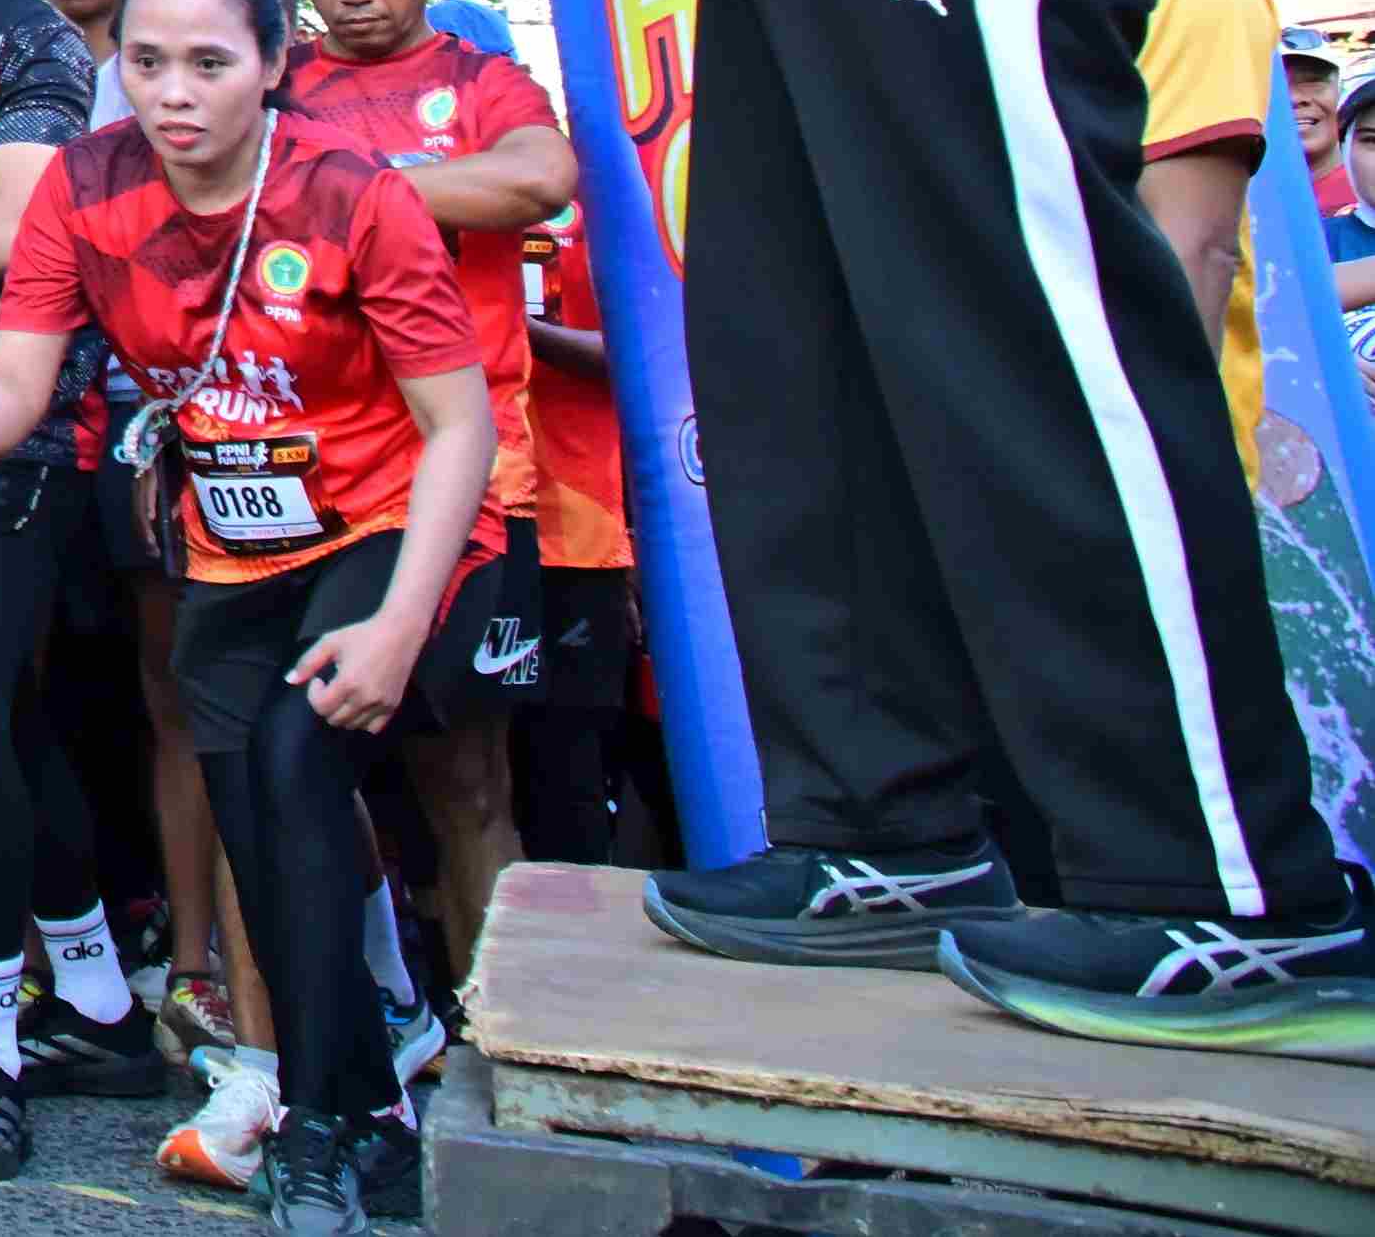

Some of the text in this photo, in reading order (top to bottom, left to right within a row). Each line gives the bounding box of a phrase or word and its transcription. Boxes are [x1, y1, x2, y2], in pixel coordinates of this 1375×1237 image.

[423, 135, 454, 148] PPNI
[265, 306, 301, 323] PPNI
[199, 388, 267, 425] RUN
[216, 444, 249, 457] PPNI
[287, 449, 306, 460] KM
[210, 486, 283, 518] 0188
[62, 941, 104, 961] alo
[0, 985, 19, 1008] al
